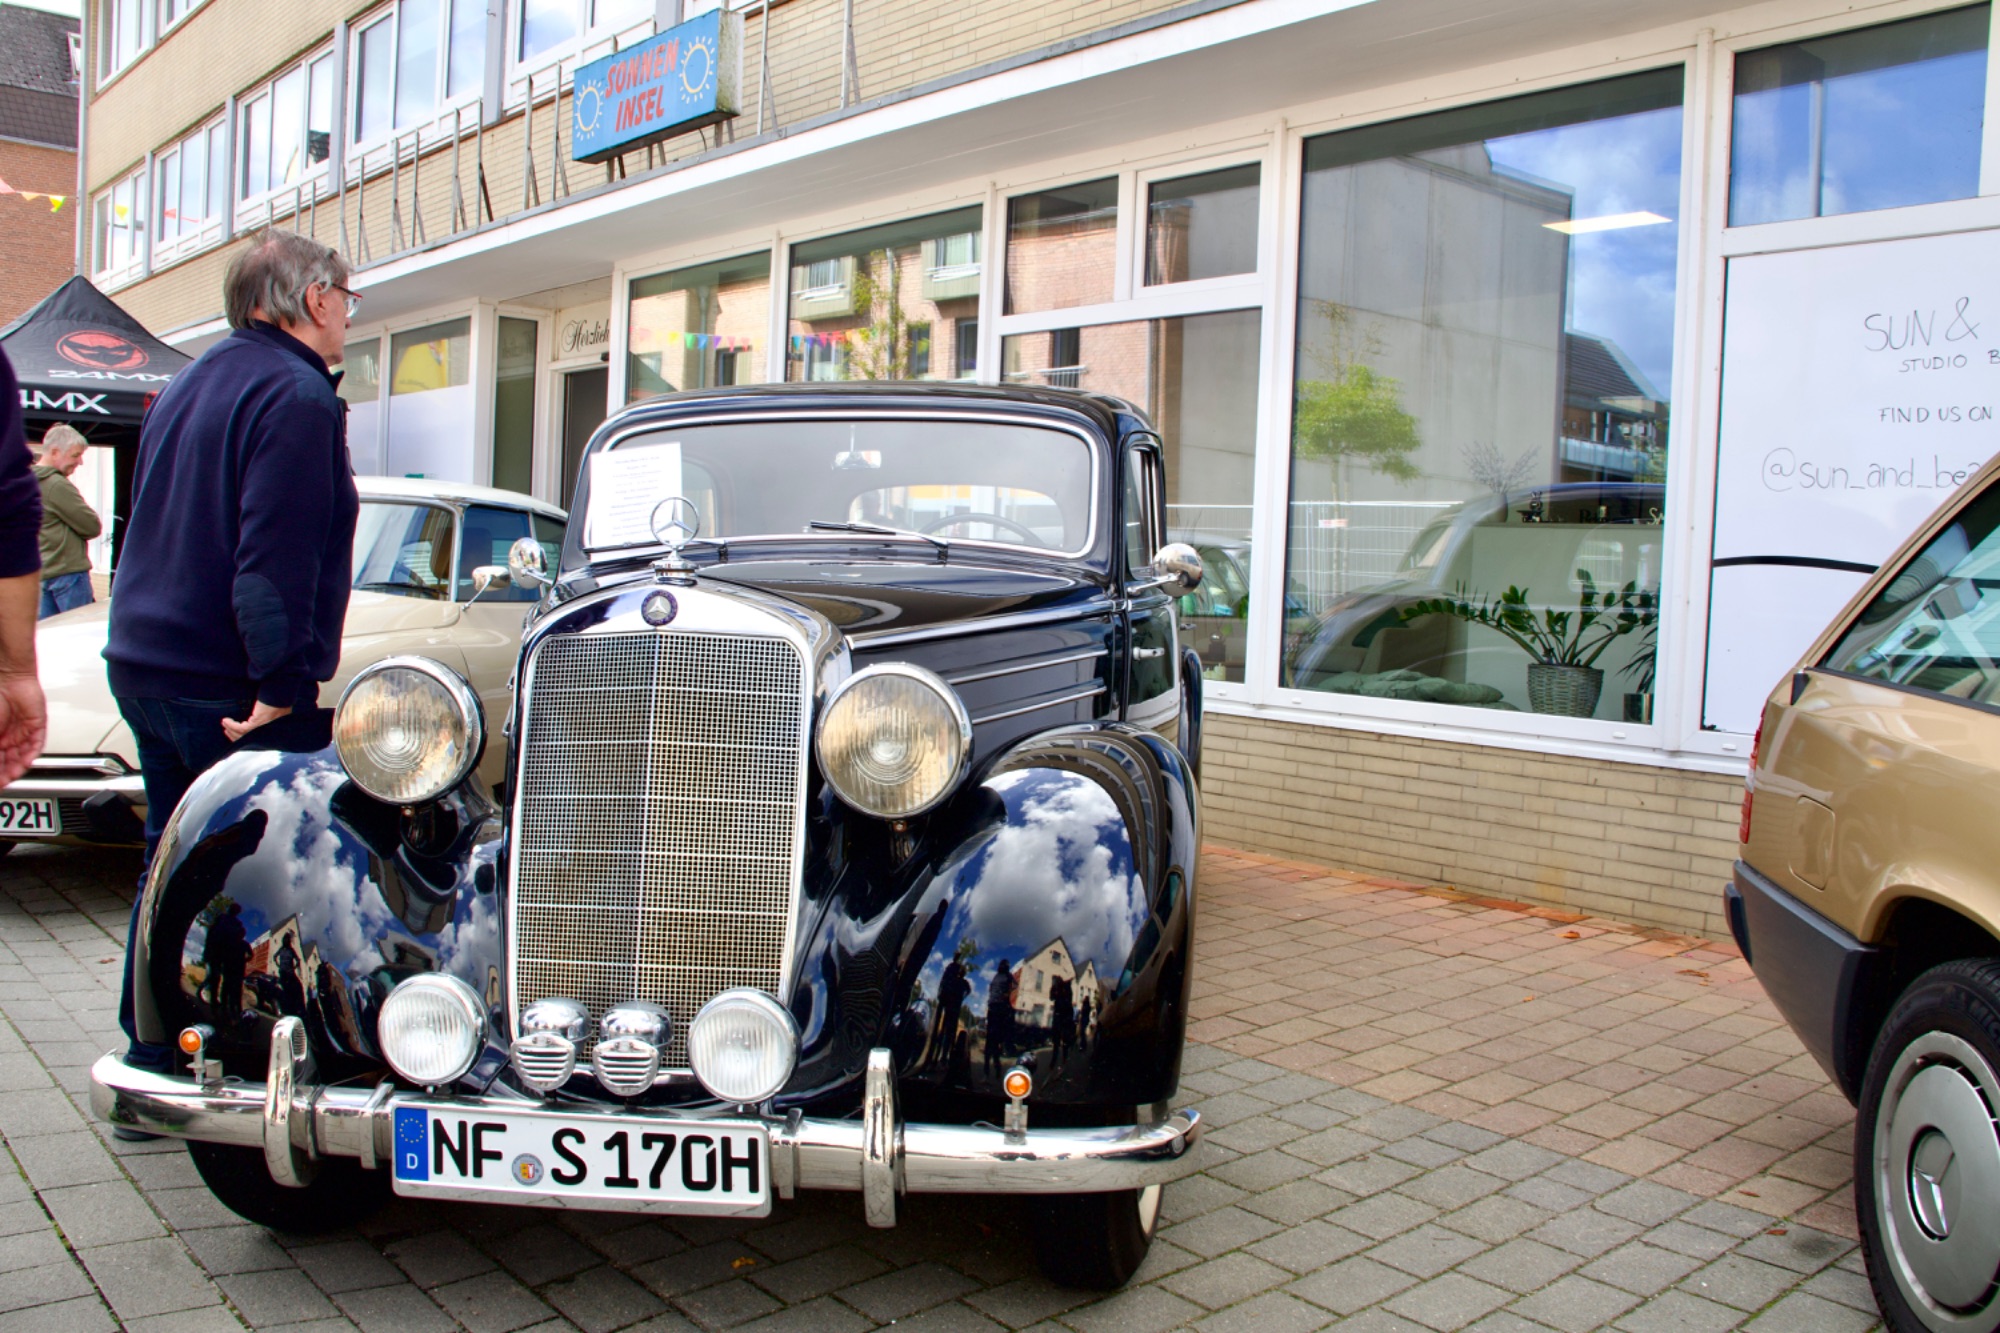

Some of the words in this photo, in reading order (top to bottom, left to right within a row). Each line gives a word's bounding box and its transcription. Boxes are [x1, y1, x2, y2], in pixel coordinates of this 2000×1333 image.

[605, 37, 680, 99] SONNEN
[615, 85, 664, 132] INSEL
[1864, 309, 1936, 351] SUN
[1945, 296, 1981, 342] &
[1898, 354, 1968, 373] STUDIO
[1878, 406, 1930, 424] FIND
[1938, 406, 1962, 423] US
[1968, 405, 1993, 421] ON
[406, 1152, 419, 1170] D
[432, 1118, 507, 1179] NF
